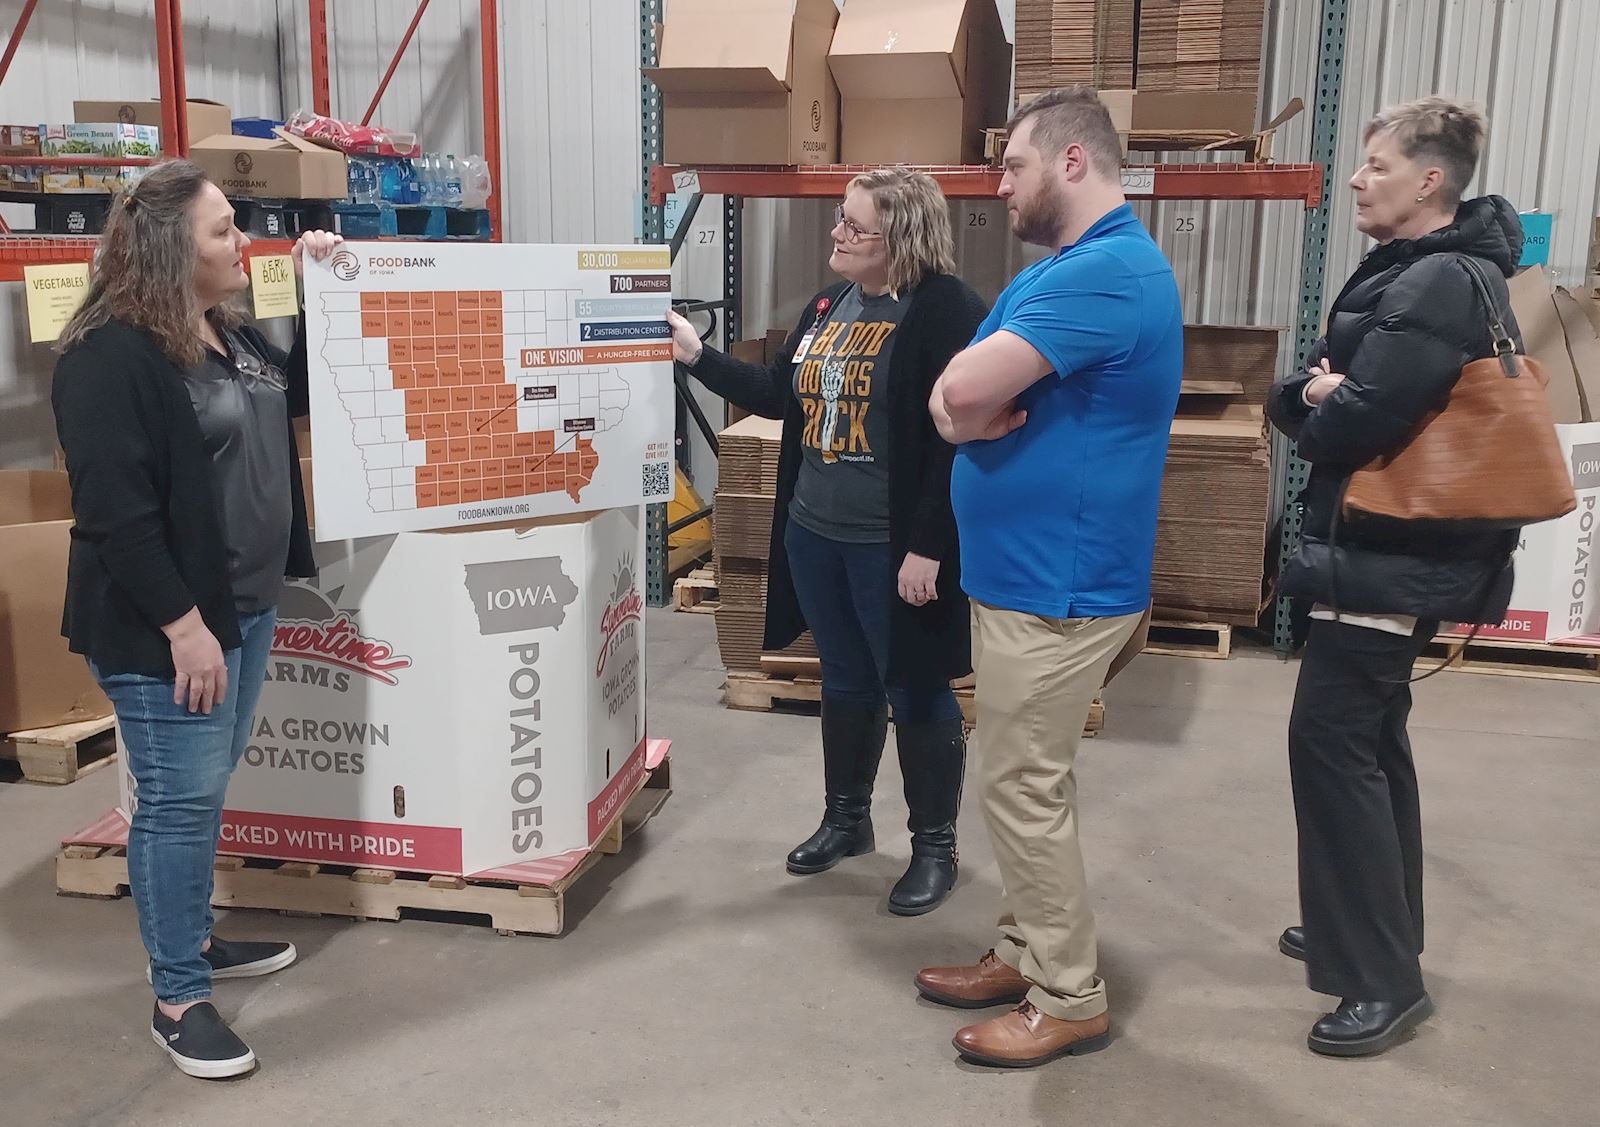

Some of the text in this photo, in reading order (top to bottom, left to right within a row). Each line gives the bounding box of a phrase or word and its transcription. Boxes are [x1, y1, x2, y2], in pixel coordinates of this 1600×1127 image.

[90, 130, 114, 138] Beans
[222, 180, 267, 188] FOODBANK
[968, 213, 987, 227] 26
[1175, 218, 1195, 232] 25
[699, 230, 715, 244] 27
[369, 257, 436, 267] FOODBANK
[582, 253, 618, 267] 30,000
[33, 277, 84, 290] VEGETABLES
[613, 277, 668, 291] 700 PARTNERS
[579, 301, 592, 315] 55
[584, 325, 670, 339] 2 DISTRIBUTION CENTERS
[809, 321, 897, 357] BLOOD
[525, 351, 546, 366] ONE
[549, 349, 584, 364] VISION
[603, 350, 650, 359] HUNGER-FREE
[651, 348, 670, 356] IOWA
[798, 359, 875, 397] DORS
[1577, 460, 1600, 476] IOW
[458, 504, 530, 520] FOODBANKIOWA.ORG
[1568, 495, 1596, 632] POTATOES
[487, 585, 557, 610] IOWA
[1498, 619, 1531, 632] RIDE
[610, 622, 634, 657] FARMS
[264, 662, 350, 693] RMS
[603, 674, 620, 703] IOWA
[608, 676, 636, 720] POTATOES
[282, 718, 389, 746] GROWN
[508, 642, 543, 855] POTATOES
[244, 745, 364, 775] OTATOES
[598, 789, 618, 825] PACKED
[217, 823, 416, 858] CKED WITH PRIDE
